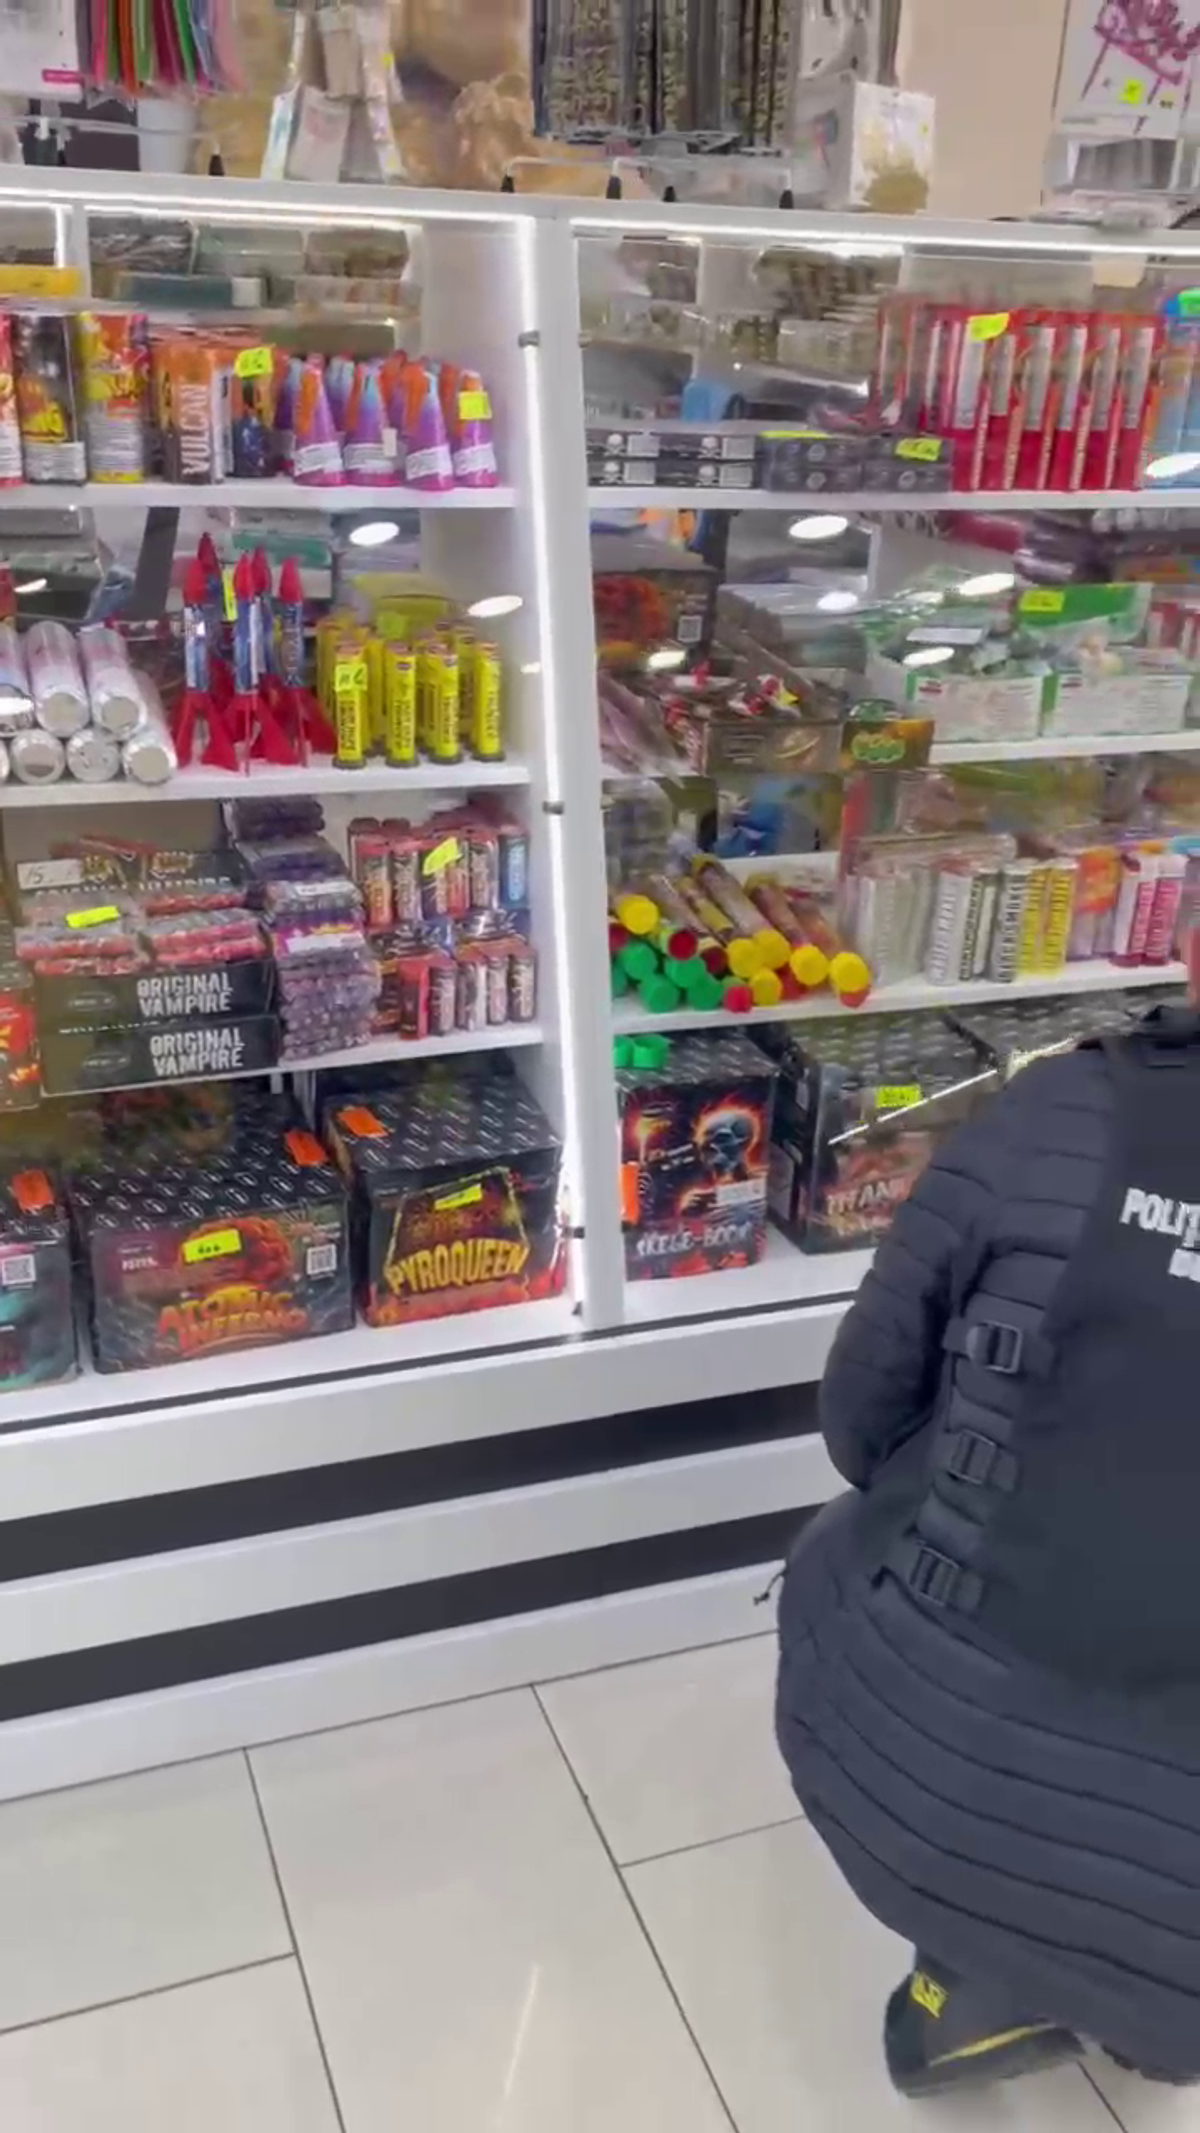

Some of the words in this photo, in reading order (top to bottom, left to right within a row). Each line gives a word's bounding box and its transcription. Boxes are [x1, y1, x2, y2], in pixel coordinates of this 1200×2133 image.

[179, 384, 211, 475] VULCAN
[136, 971, 234, 998] ORIGINAL
[138, 992, 233, 1018] VAMPIRE
[150, 1026, 245, 1056] ORIGINAL
[152, 1049, 244, 1078] VAMPIRE
[387, 1238, 529, 1296] PYROQUEEN
